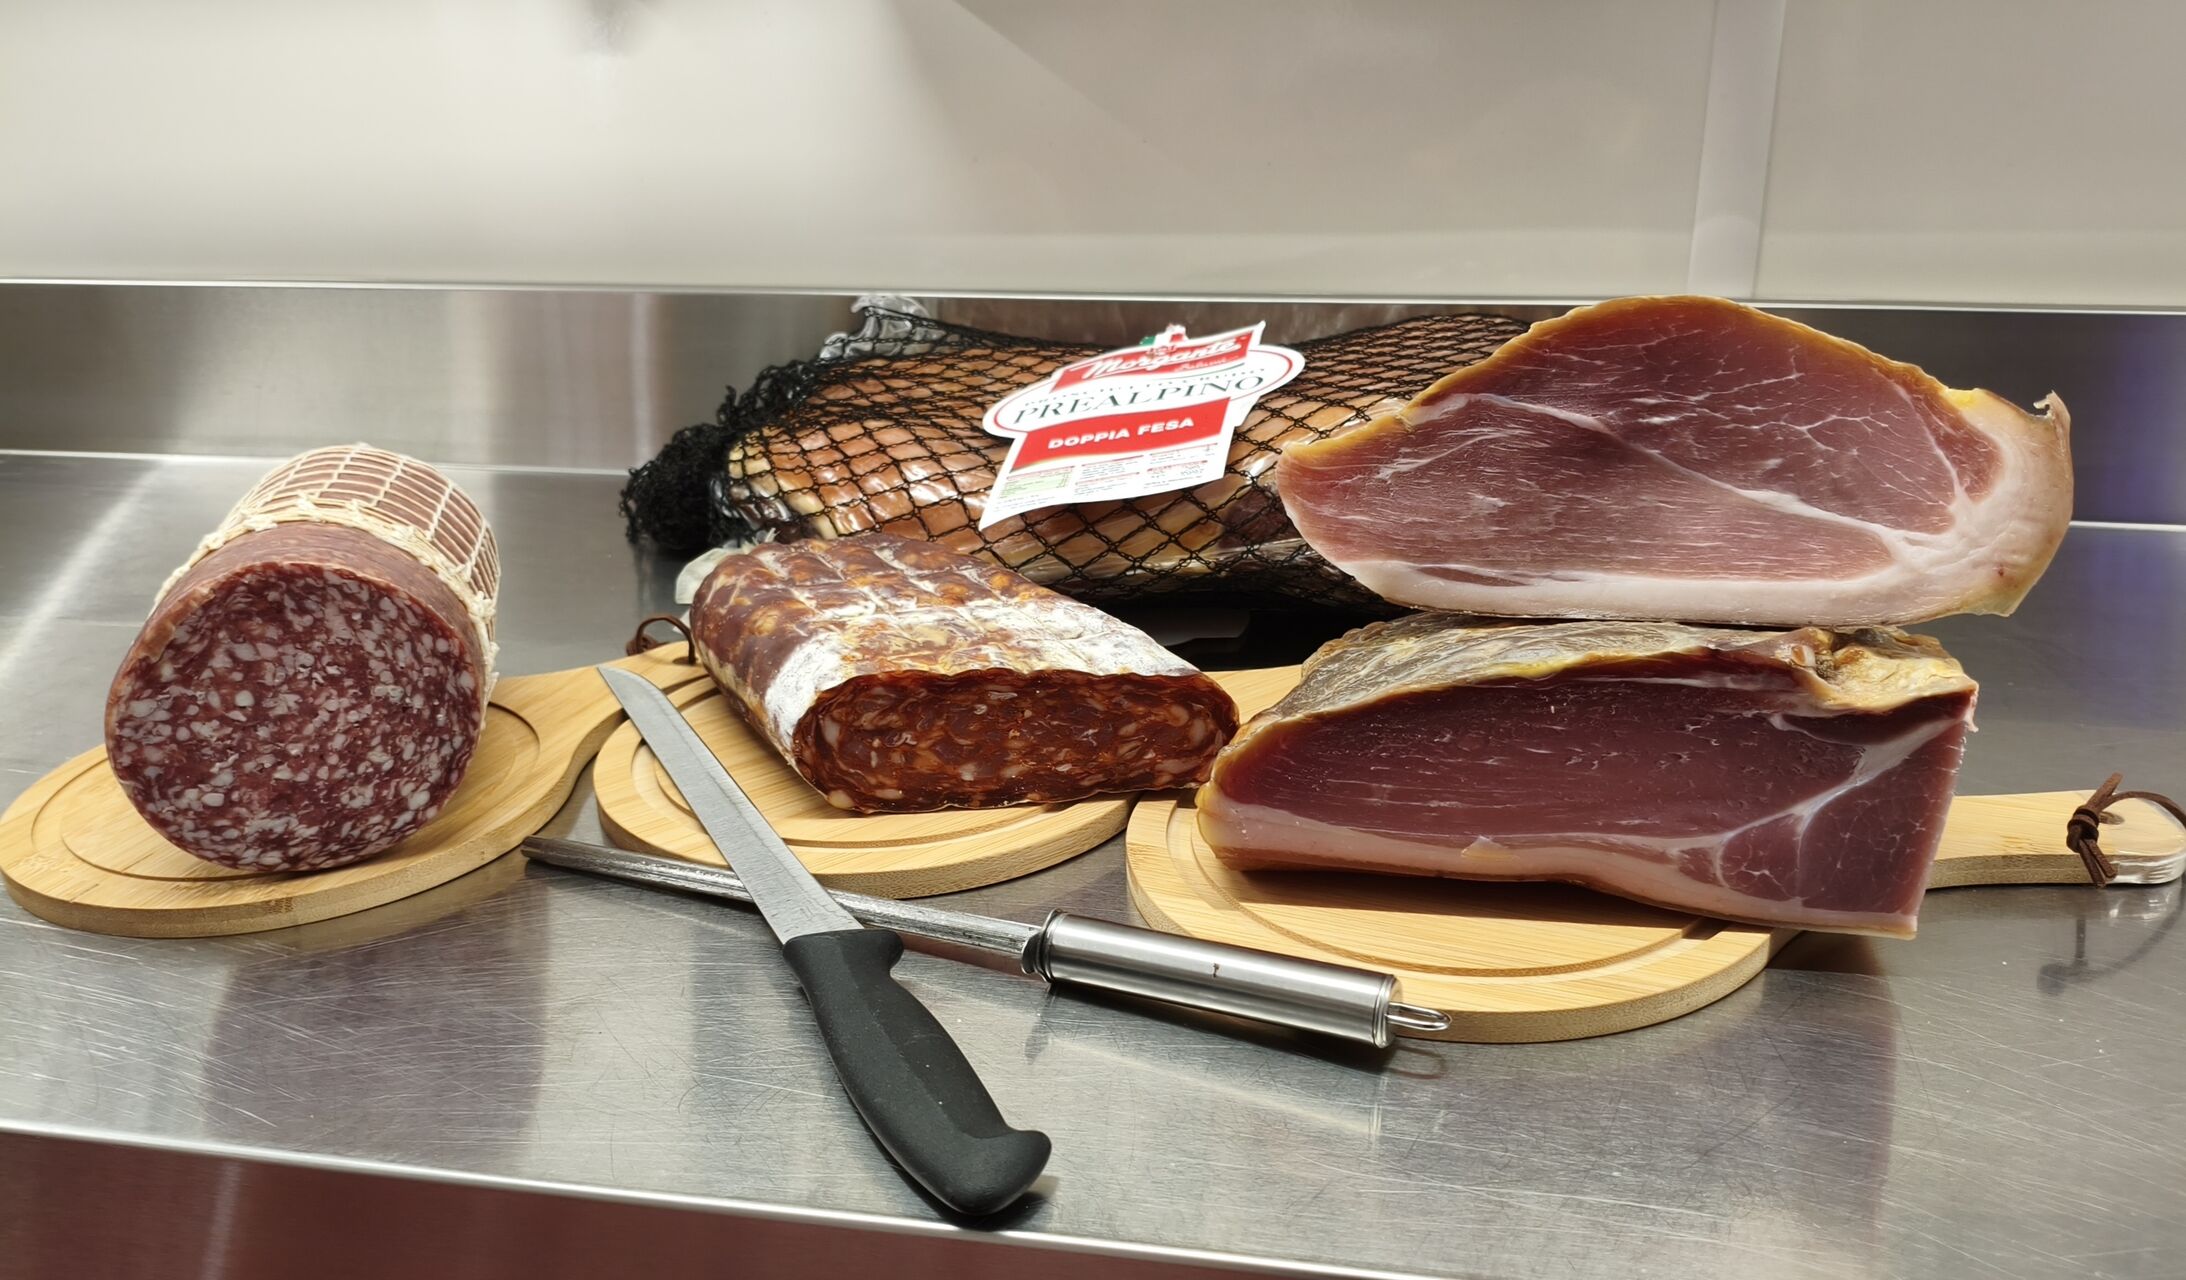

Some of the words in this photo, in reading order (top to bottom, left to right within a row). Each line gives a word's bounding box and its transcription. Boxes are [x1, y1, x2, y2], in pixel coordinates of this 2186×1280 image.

[1080, 337, 1242, 379] Morgante
[1013, 375, 1265, 424] PREALPINO
[1047, 428, 1131, 450] DOPPIA
[1137, 417, 1195, 436] FESA
